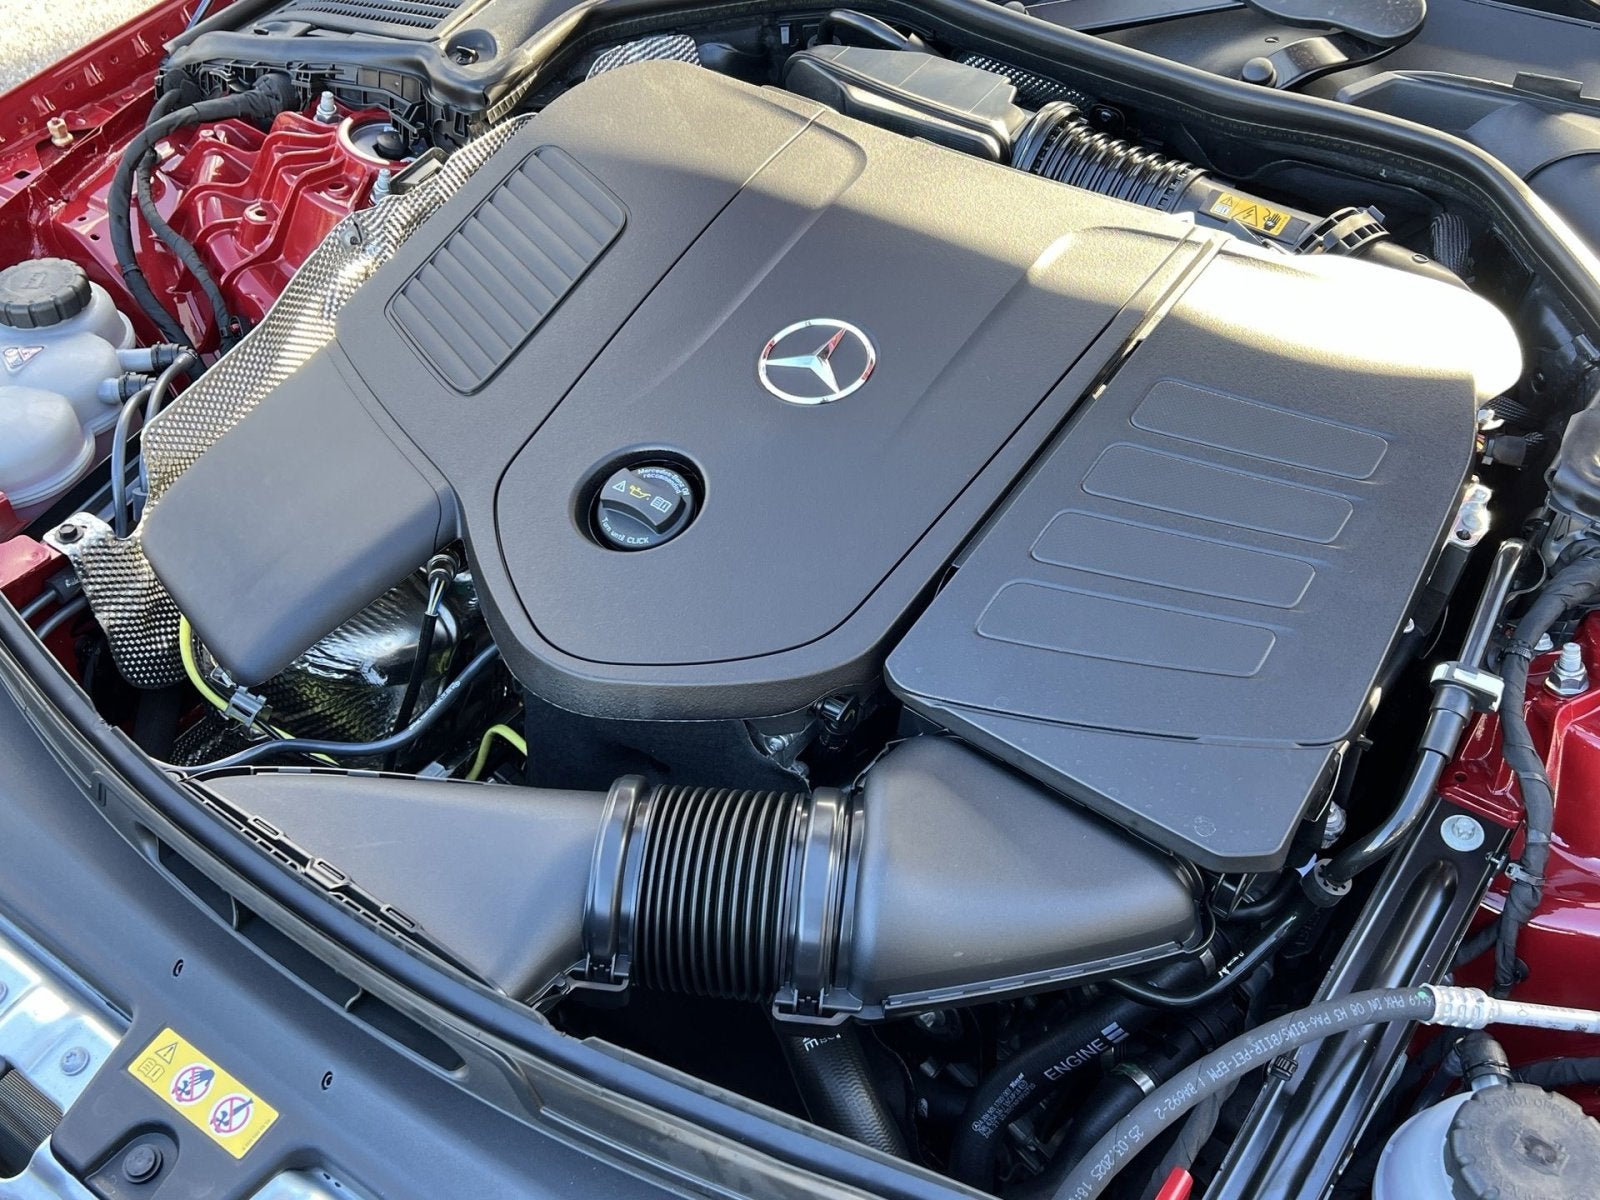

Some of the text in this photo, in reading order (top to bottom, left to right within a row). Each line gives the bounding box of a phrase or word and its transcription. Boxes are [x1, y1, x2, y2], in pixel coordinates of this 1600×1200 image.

[602, 517, 650, 545] Turn until CLICK
[1350, 1002, 1365, 1016] 08
[1384, 995, 1406, 1010] PHX
[1333, 1007, 1348, 1023] H3
[1043, 1038, 1109, 1081] ENGINE
[1090, 1124, 1144, 1181] 25.03.2025
[1068, 1181, 1093, 1200] 18:
